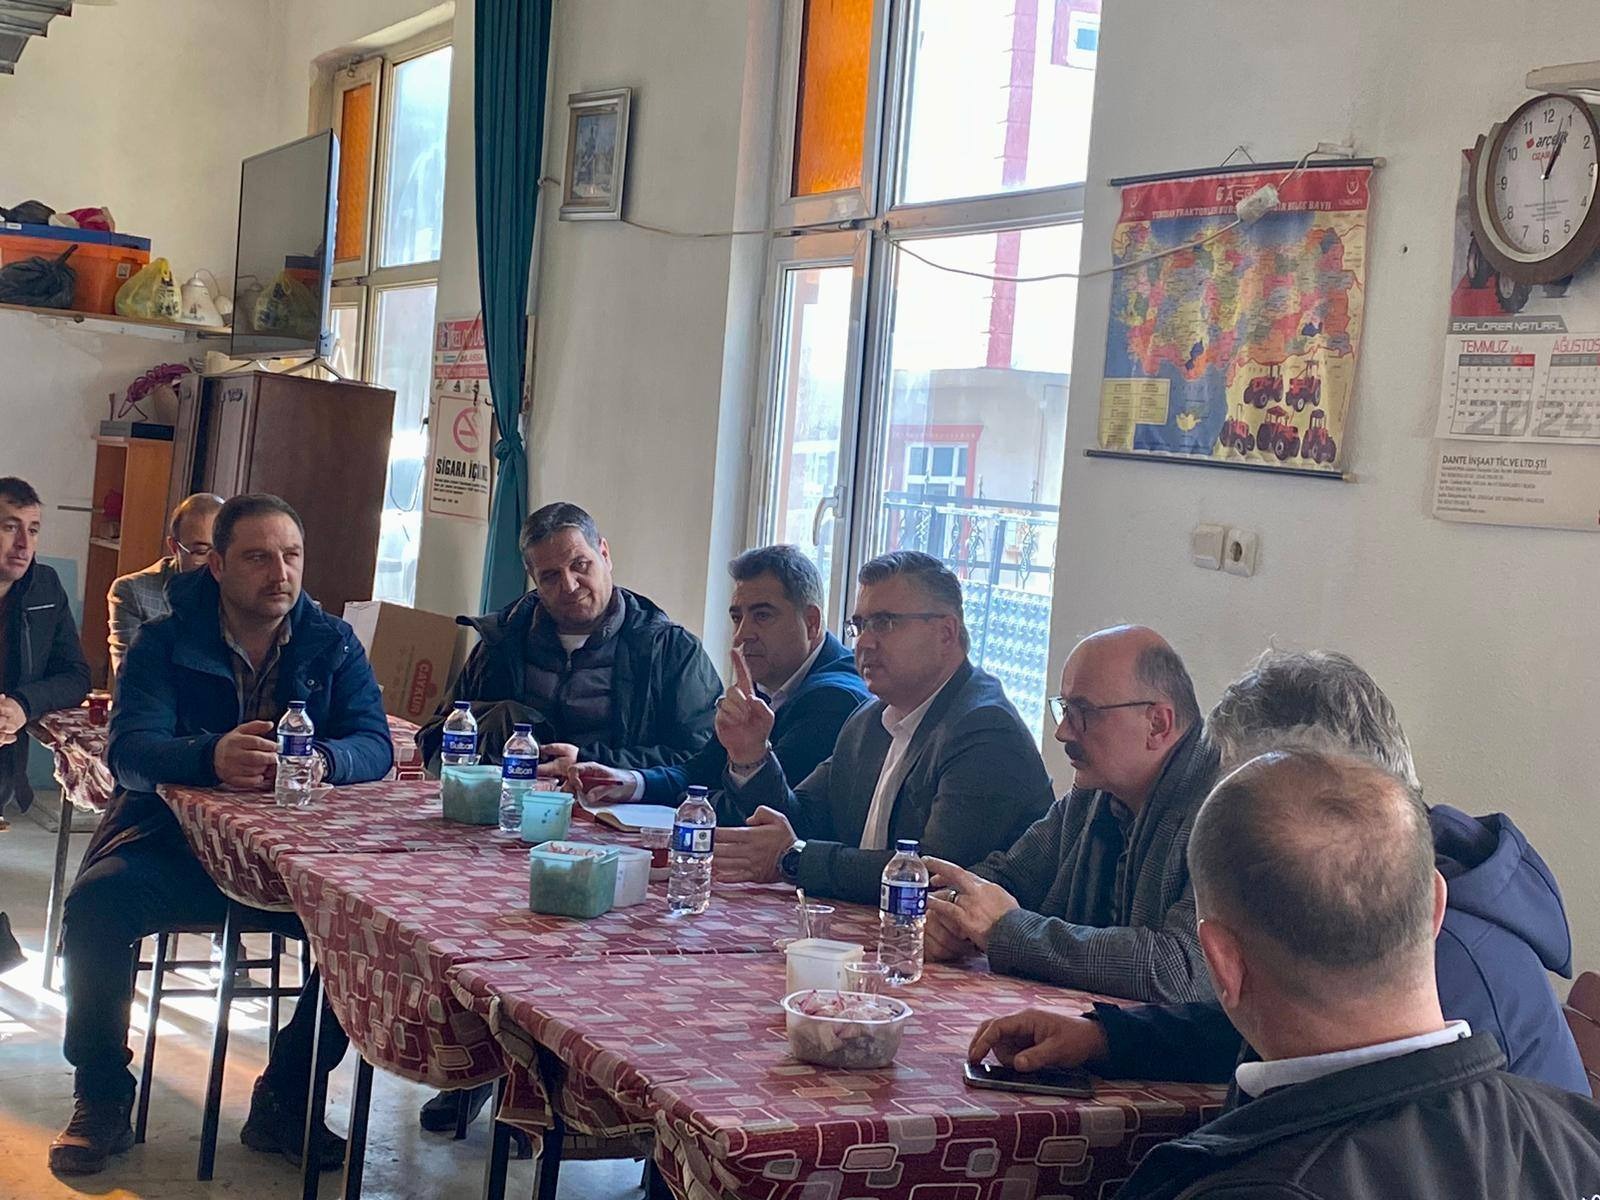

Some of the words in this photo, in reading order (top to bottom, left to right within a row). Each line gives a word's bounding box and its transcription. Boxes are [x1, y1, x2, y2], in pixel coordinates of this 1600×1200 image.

[1543, 109, 1555, 123] 12
[1567, 114, 1573, 128] 1
[1524, 121, 1533, 135] 11
[1583, 135, 1591, 150] 2
[1507, 147, 1518, 161] 10
[1500, 176, 1508, 191] 9
[1580, 195, 1588, 207] 4
[1507, 205, 1514, 220] 8
[1522, 225, 1530, 238] 7
[1563, 219, 1571, 234] 5
[1542, 229, 1550, 245] 6
[1460, 340, 1509, 354] TEMMUZ
[436, 456, 466, 478] SİGARA
[1442, 455, 1467, 465] DANTE
